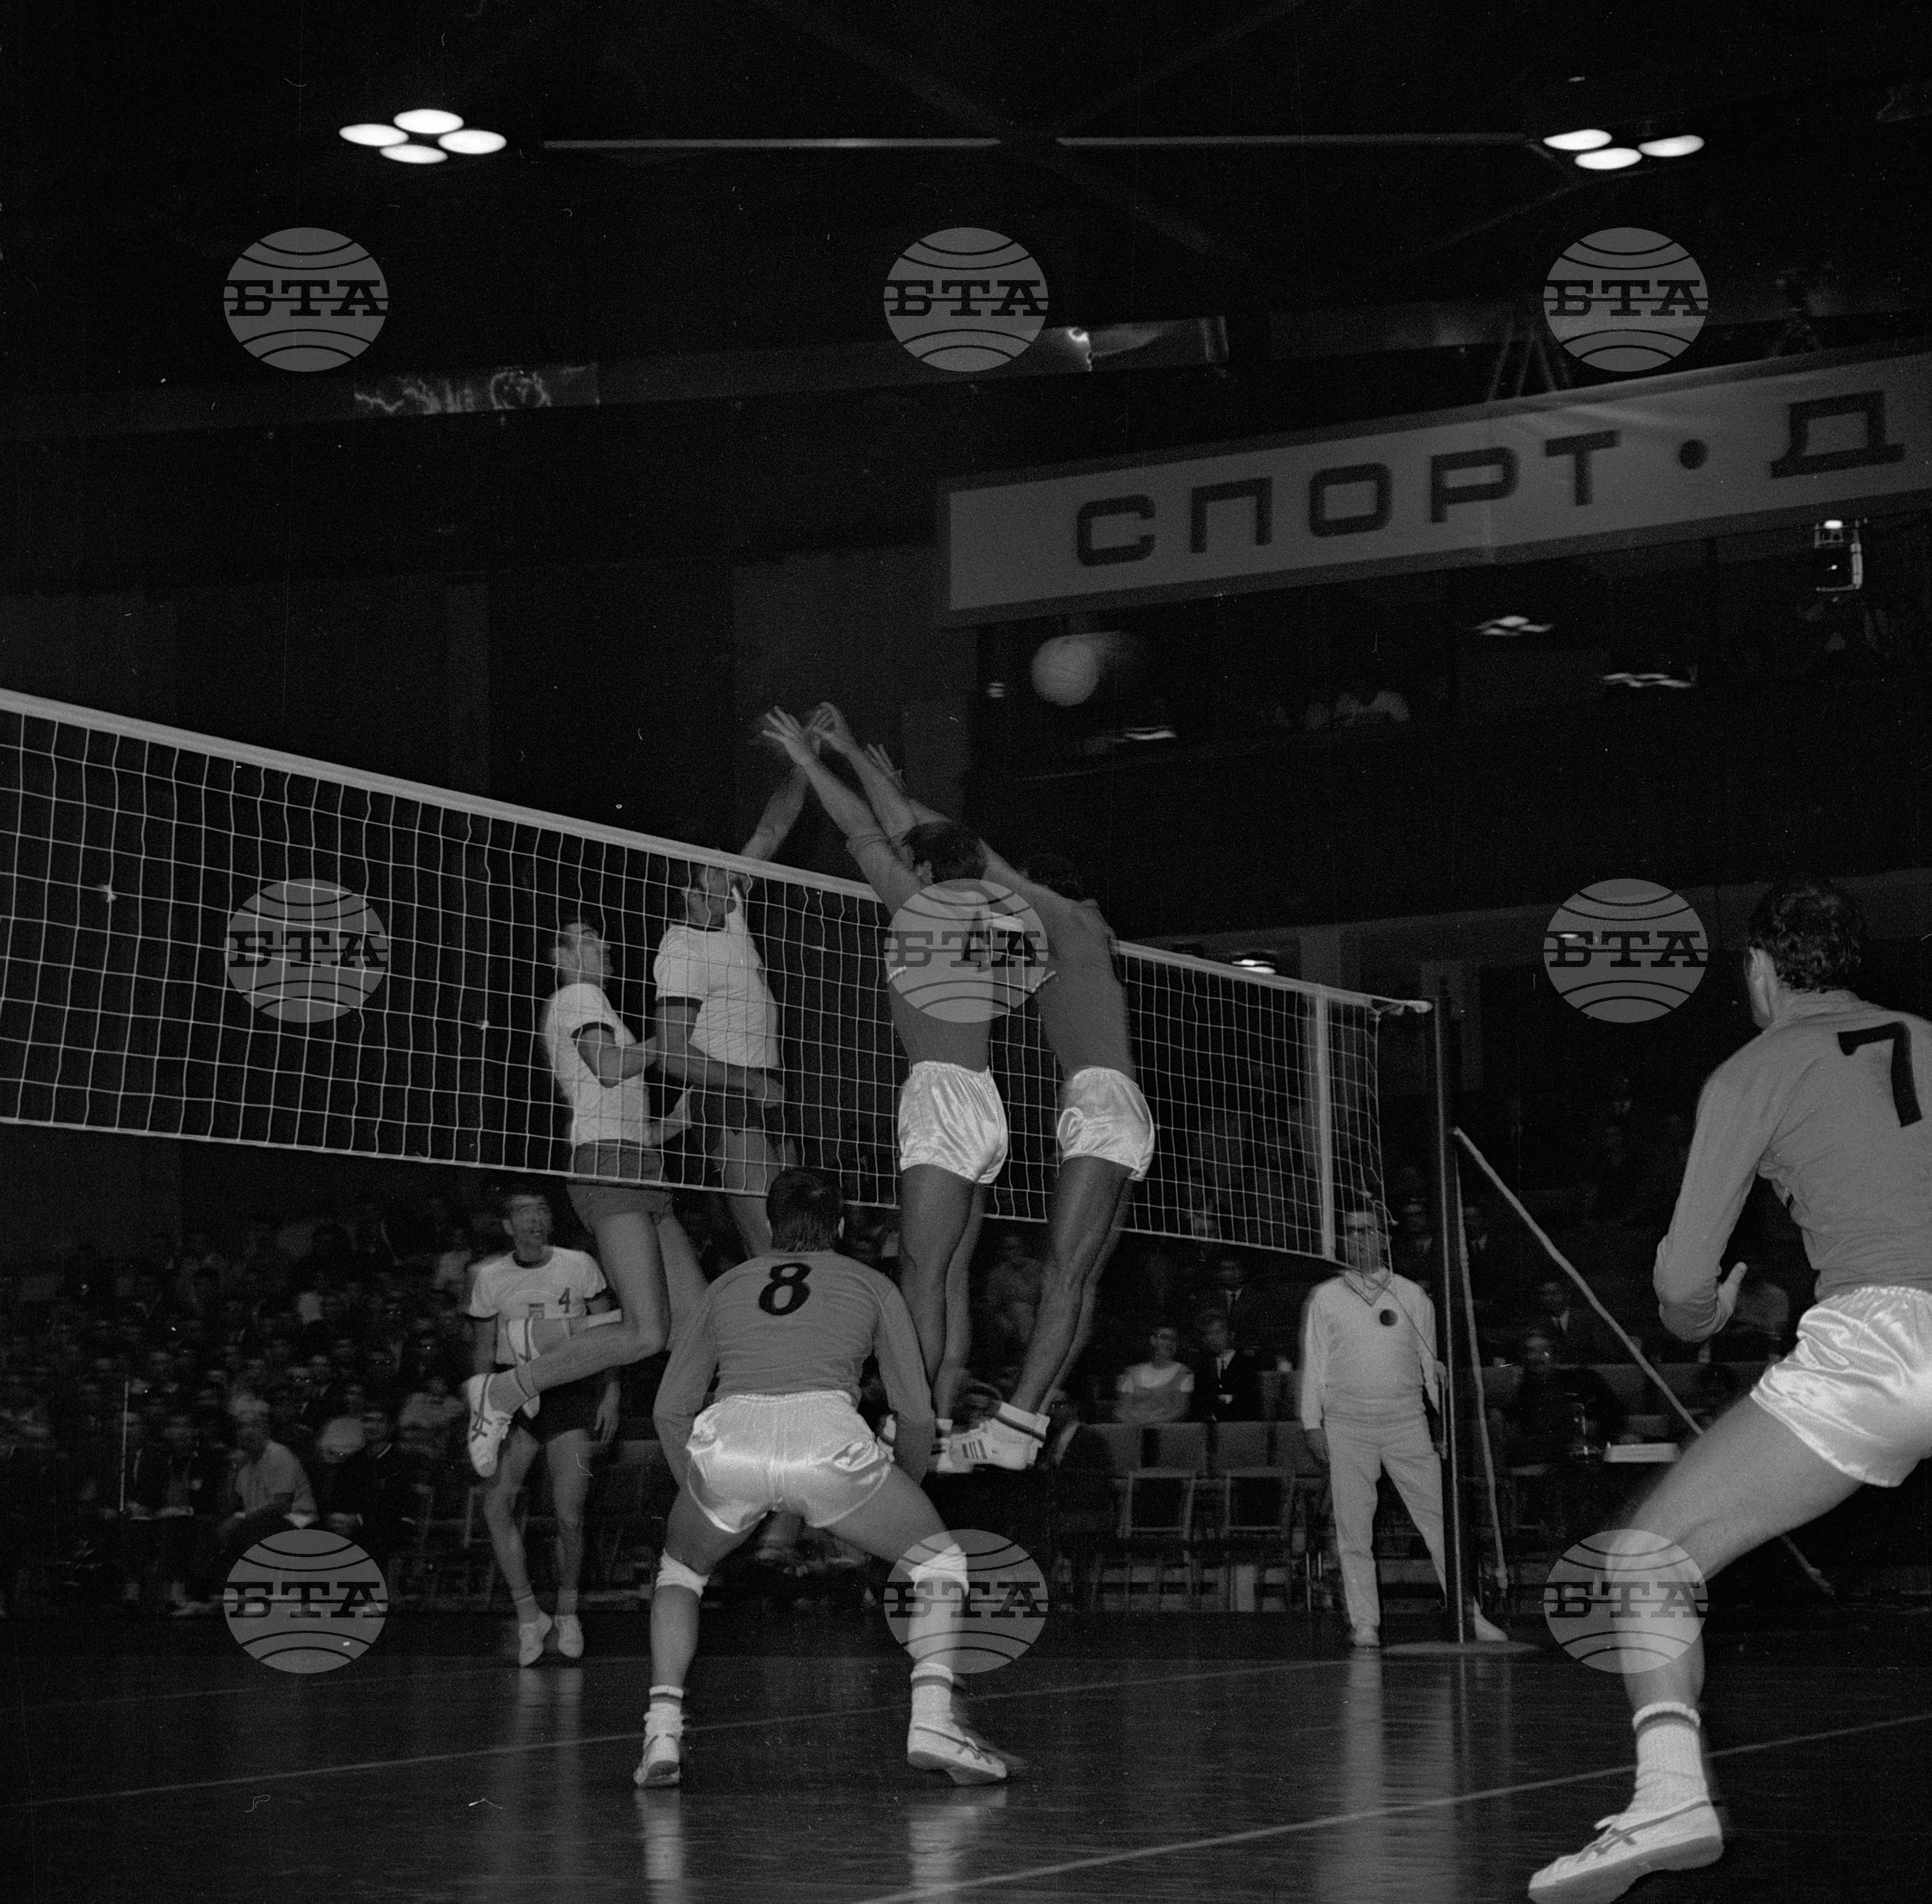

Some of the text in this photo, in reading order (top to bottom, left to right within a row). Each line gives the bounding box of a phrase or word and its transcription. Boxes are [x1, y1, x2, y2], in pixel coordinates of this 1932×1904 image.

[1076, 429, 1621, 568] СПОРТ
[1838, 1021, 1922, 1127] 7
[558, 1288, 570, 1314] 4
[759, 1263, 810, 1315] 8
